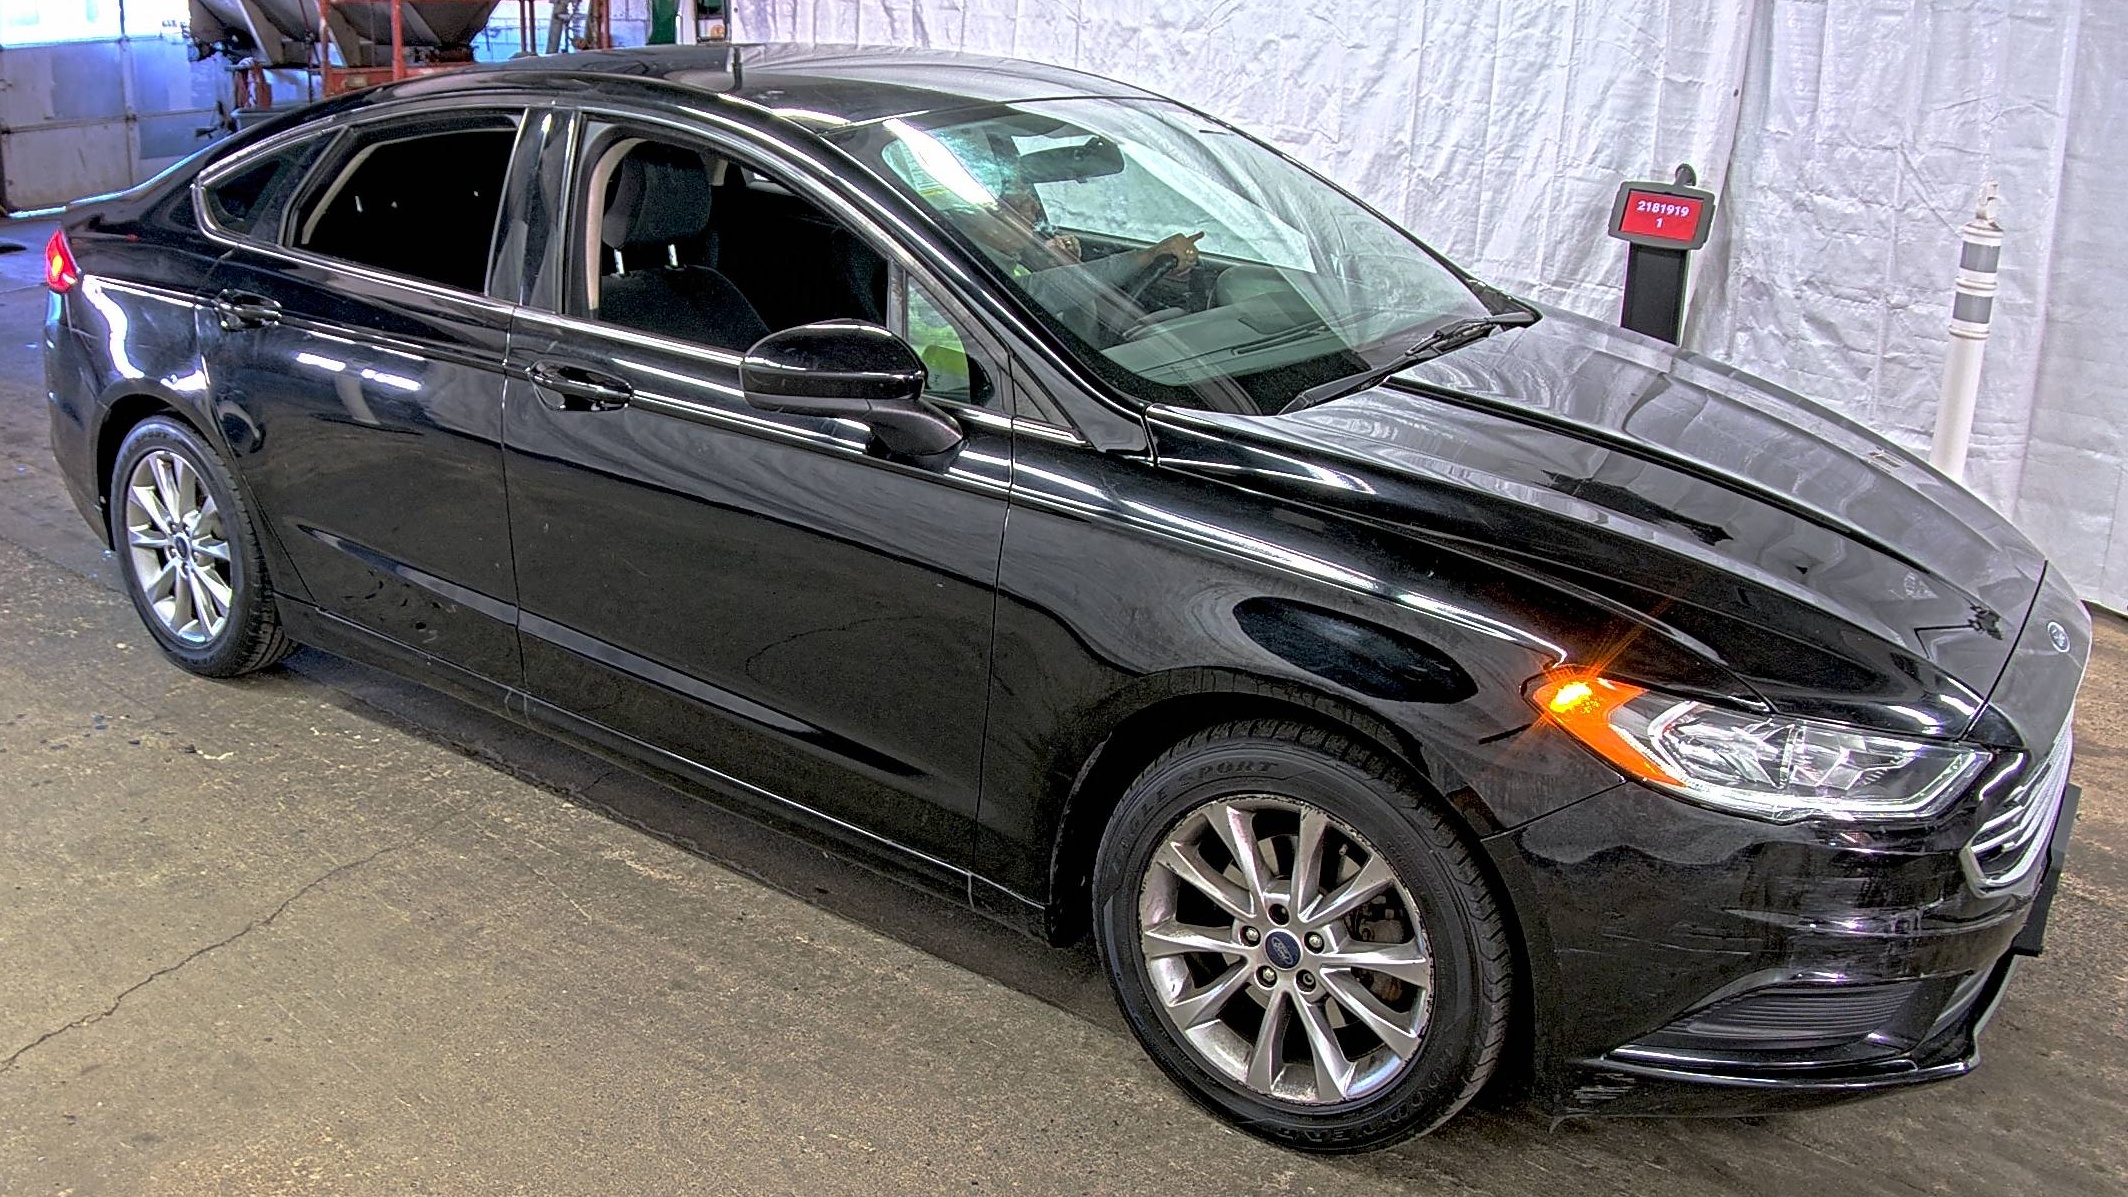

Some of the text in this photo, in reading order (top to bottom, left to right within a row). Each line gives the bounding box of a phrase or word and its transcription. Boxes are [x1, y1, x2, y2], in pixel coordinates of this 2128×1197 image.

[1637, 200, 1690, 217] 2181919
[1656, 218, 1663, 228] 1
[1176, 760, 1278, 788] SPORT
